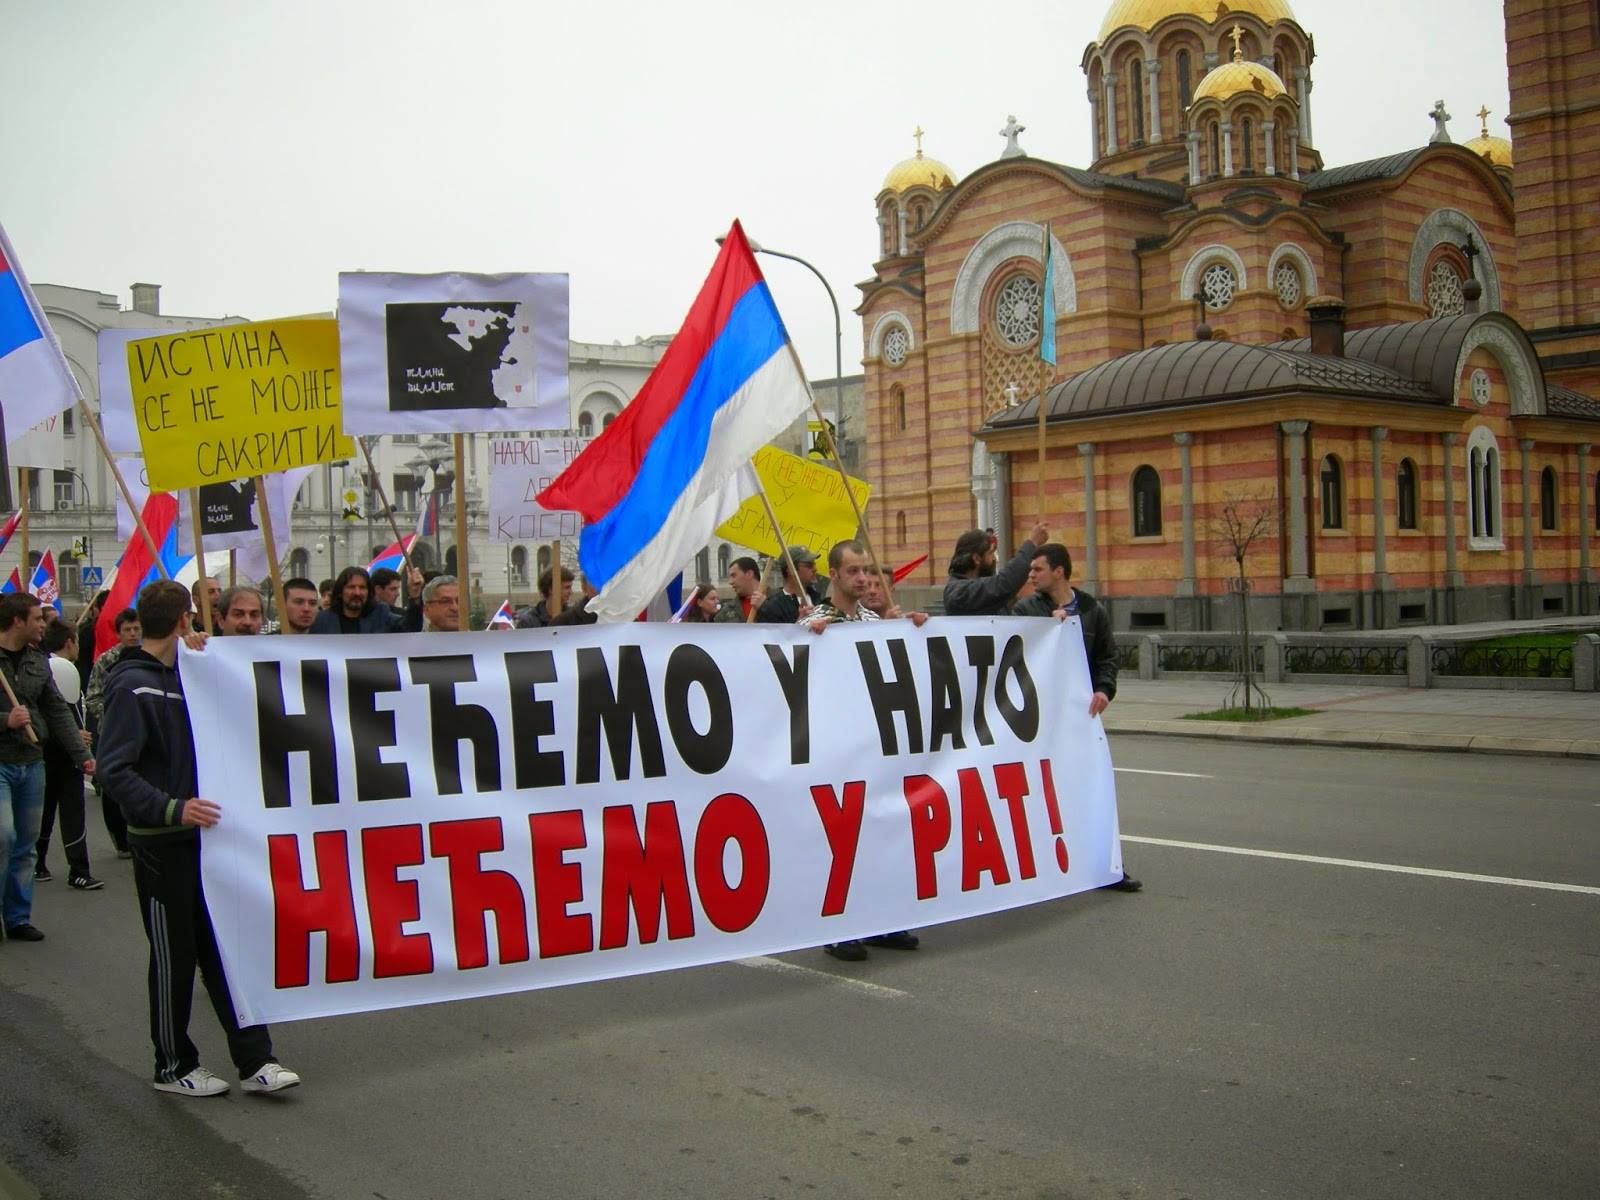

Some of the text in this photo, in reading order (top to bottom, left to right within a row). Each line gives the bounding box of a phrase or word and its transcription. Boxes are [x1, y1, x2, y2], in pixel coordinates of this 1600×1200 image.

[135, 329, 289, 383] ИСТИНА
[142, 368, 338, 432] СЕ НЕ МОЖЕ
[494, 440, 540, 465] НАРКО
[563, 439, 591, 464] НА
[497, 513, 583, 539] КОСО
[252, 633, 1040, 808] НЕЋЕМО У НАТО
[267, 758, 1070, 989] НЕЋЕМО У РАТ!
